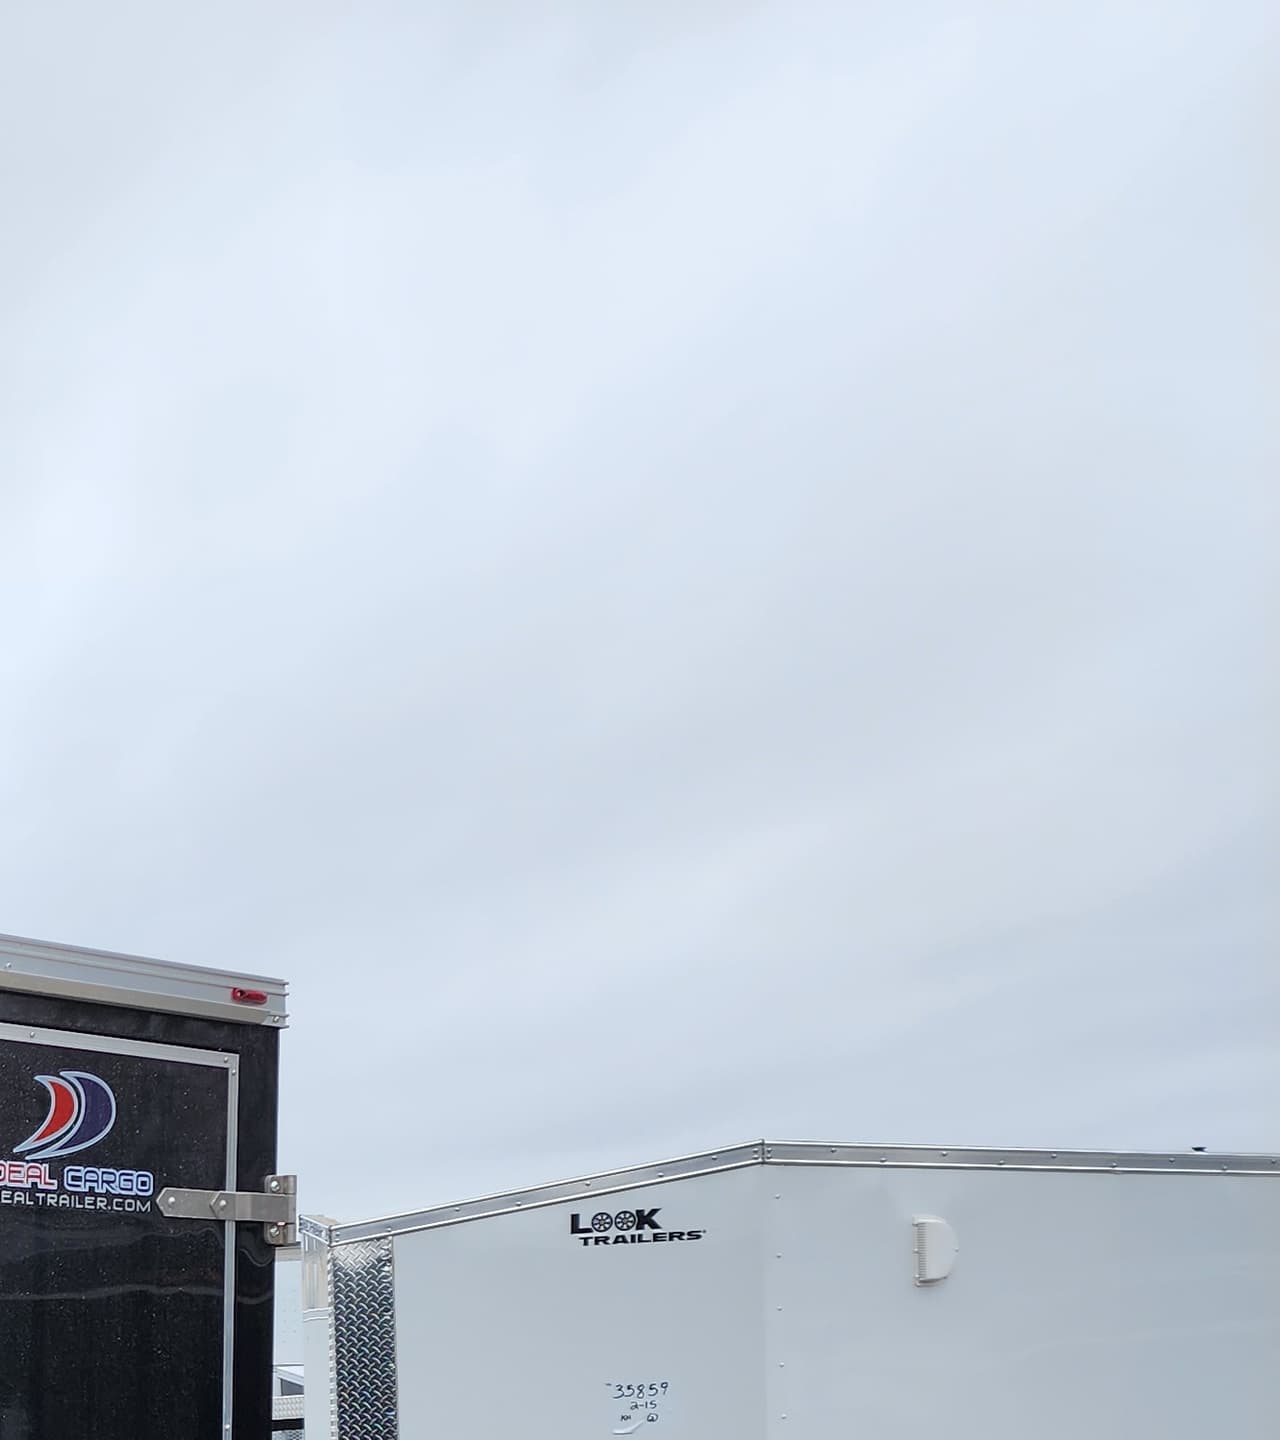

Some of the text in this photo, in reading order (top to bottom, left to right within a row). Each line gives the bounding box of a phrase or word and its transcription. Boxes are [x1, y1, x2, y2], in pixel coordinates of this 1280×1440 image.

[64, 1166, 154, 1197] CARGO
[570, 1208, 662, 1234] LOOK
[579, 1230, 703, 1246] TRAILERS
[612, 1381, 669, 1399] 35859
